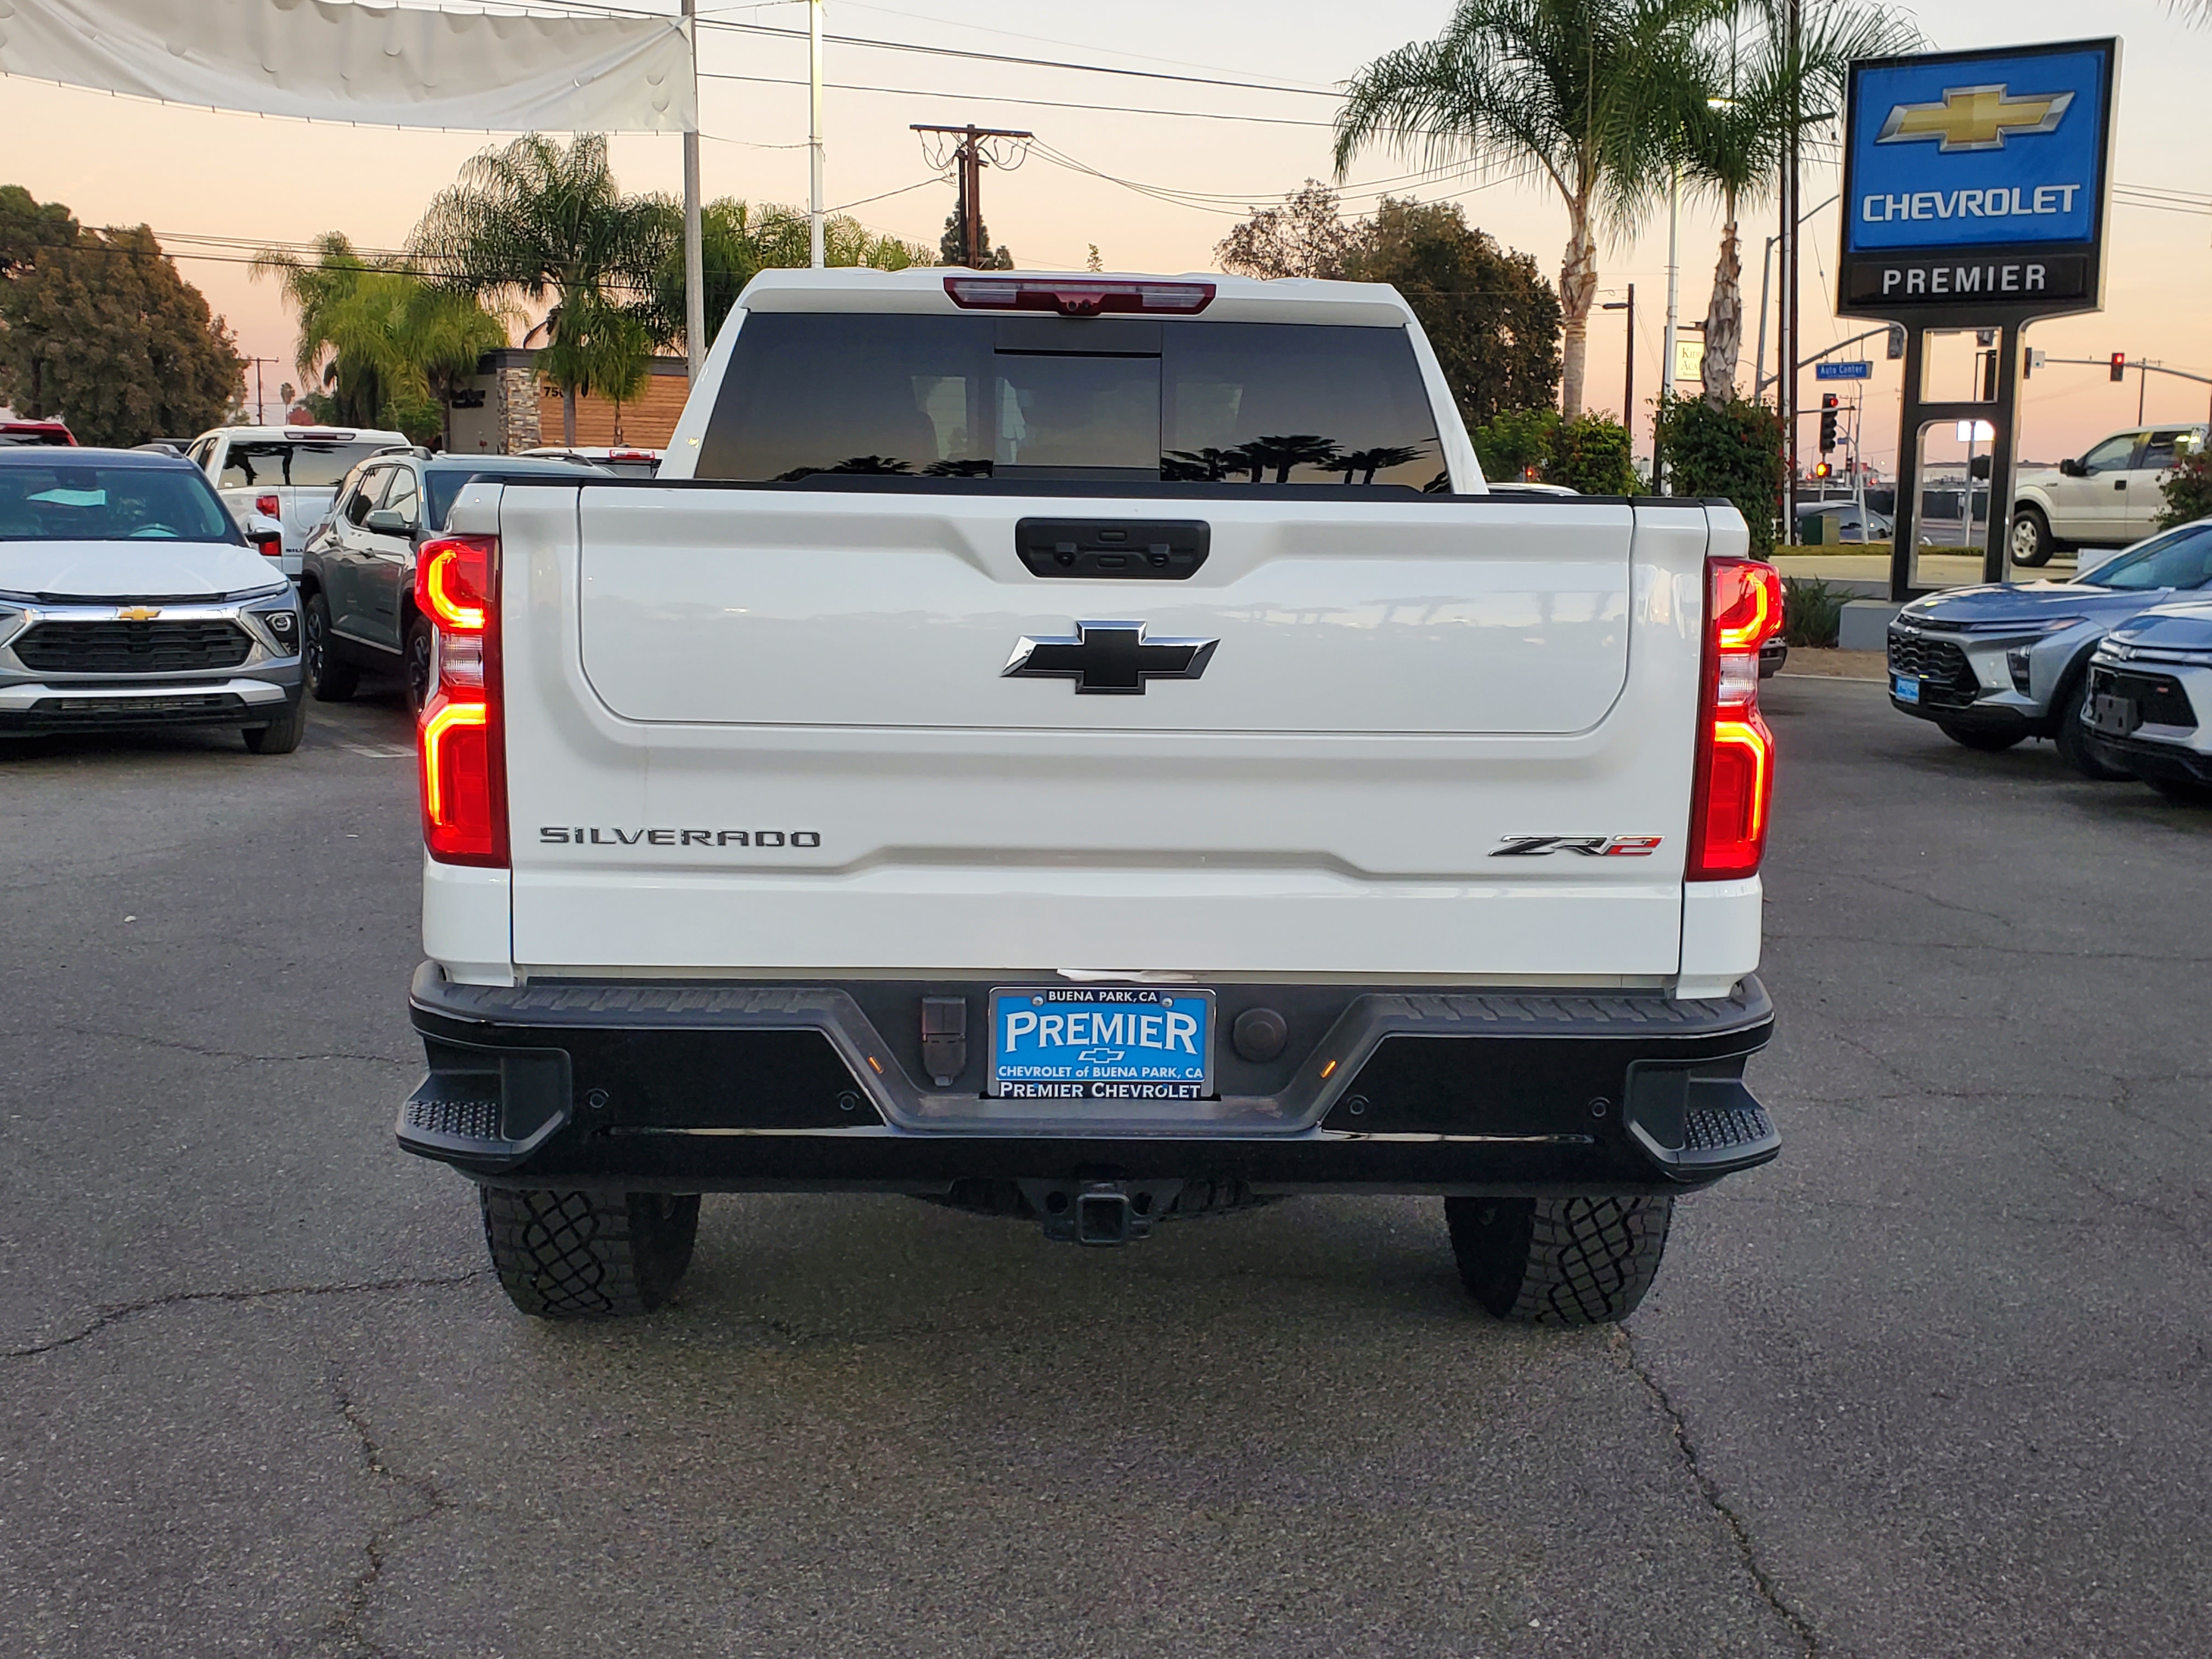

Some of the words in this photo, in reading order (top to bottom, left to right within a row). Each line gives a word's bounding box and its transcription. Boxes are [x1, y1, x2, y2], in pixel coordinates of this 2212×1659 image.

[1862, 184, 2080, 222] CHEVROLET
[1882, 263, 2047, 295] PREMIER
[1820, 365, 1837, 375] Auto
[540, 826, 821, 847] SILVERADO
[1488, 834, 1665, 856] ZR2
[1048, 991, 1094, 1002] BUENA
[1099, 991, 1137, 1003] PARK,
[1138, 992, 1158, 1002] CA
[1005, 1011, 1198, 1055] PREMIER
[998, 1065, 1073, 1077] CHEVROLET
[1075, 1065, 1090, 1077] of
[1092, 1066, 1138, 1078] BUENA
[1141, 1066, 1182, 1079] PARK,
[1185, 1067, 1204, 1079] CA
[1000, 1081, 1084, 1098] PREMIER
[1091, 1081, 1201, 1099] CHEVROLET
